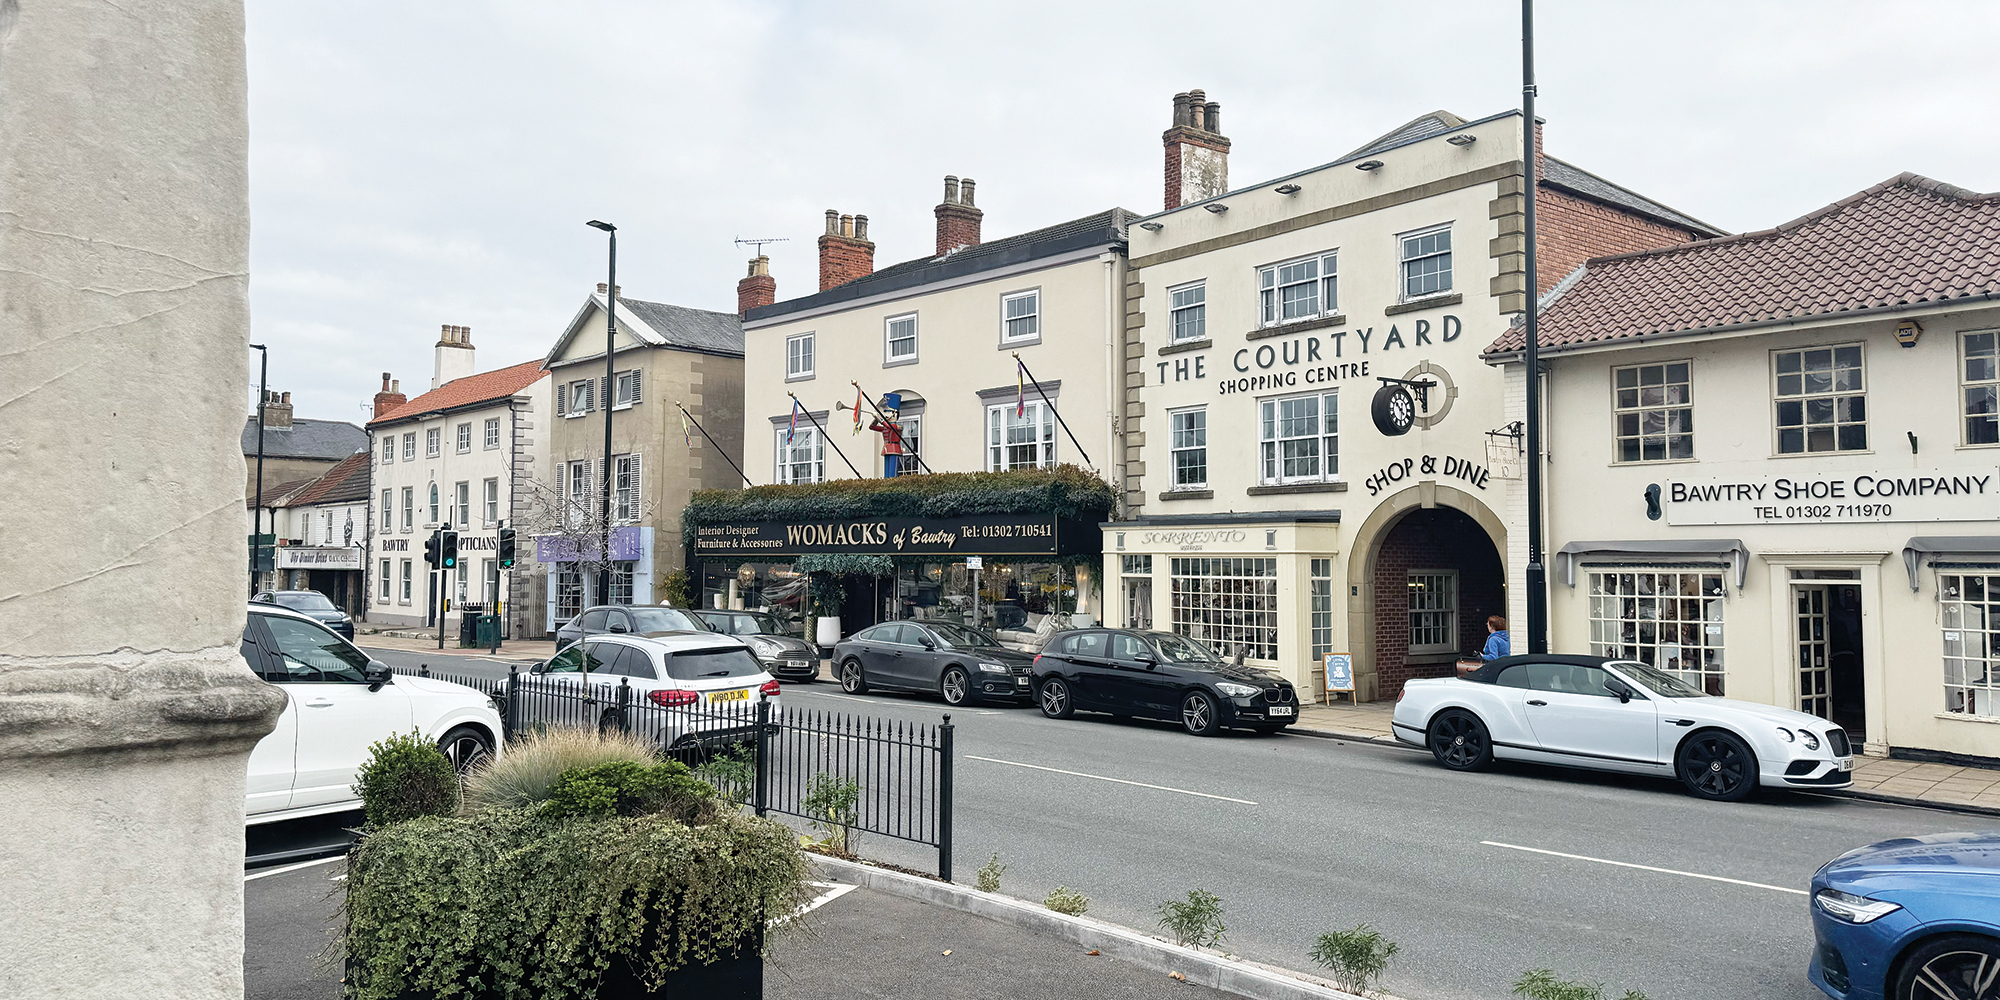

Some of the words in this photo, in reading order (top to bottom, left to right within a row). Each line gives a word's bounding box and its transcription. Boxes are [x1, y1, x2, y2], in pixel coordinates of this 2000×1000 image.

[1156, 355, 1206, 385] THE
[1233, 314, 1463, 373] COURTYARD
[1219, 371, 1297, 395] SHOPPING
[1305, 360, 1370, 384] CENTRE
[1365, 457, 1414, 497] SHOP
[1420, 454, 1437, 475] &
[1443, 455, 1489, 490] DINE
[1671, 482, 1767, 503] BAWTRY
[1773, 478, 1845, 500] SHOE
[1853, 474, 1990, 499] COMPANY
[1753, 506, 1782, 519] TEL
[1785, 505, 1832, 518] 01302
[1836, 503, 1892, 517] 711970
[698, 525, 725, 535] Interior
[726, 524, 759, 537] Designer
[786, 521, 888, 546] WOMACKS
[892, 527, 906, 550] of
[910, 525, 957, 548] Bawtry
[961, 525, 980, 538] Tel:
[982, 524, 1013, 538] 01302
[1014, 523, 1052, 537] 710541
[1141, 529, 1246, 545] SORRENTO
[382, 538, 410, 552] BAWTRY
[458, 536, 496, 551] PTICIANS
[697, 538, 731, 549] Furniture
[732, 538, 738, 549] &
[740, 538, 783, 548] Accessories
